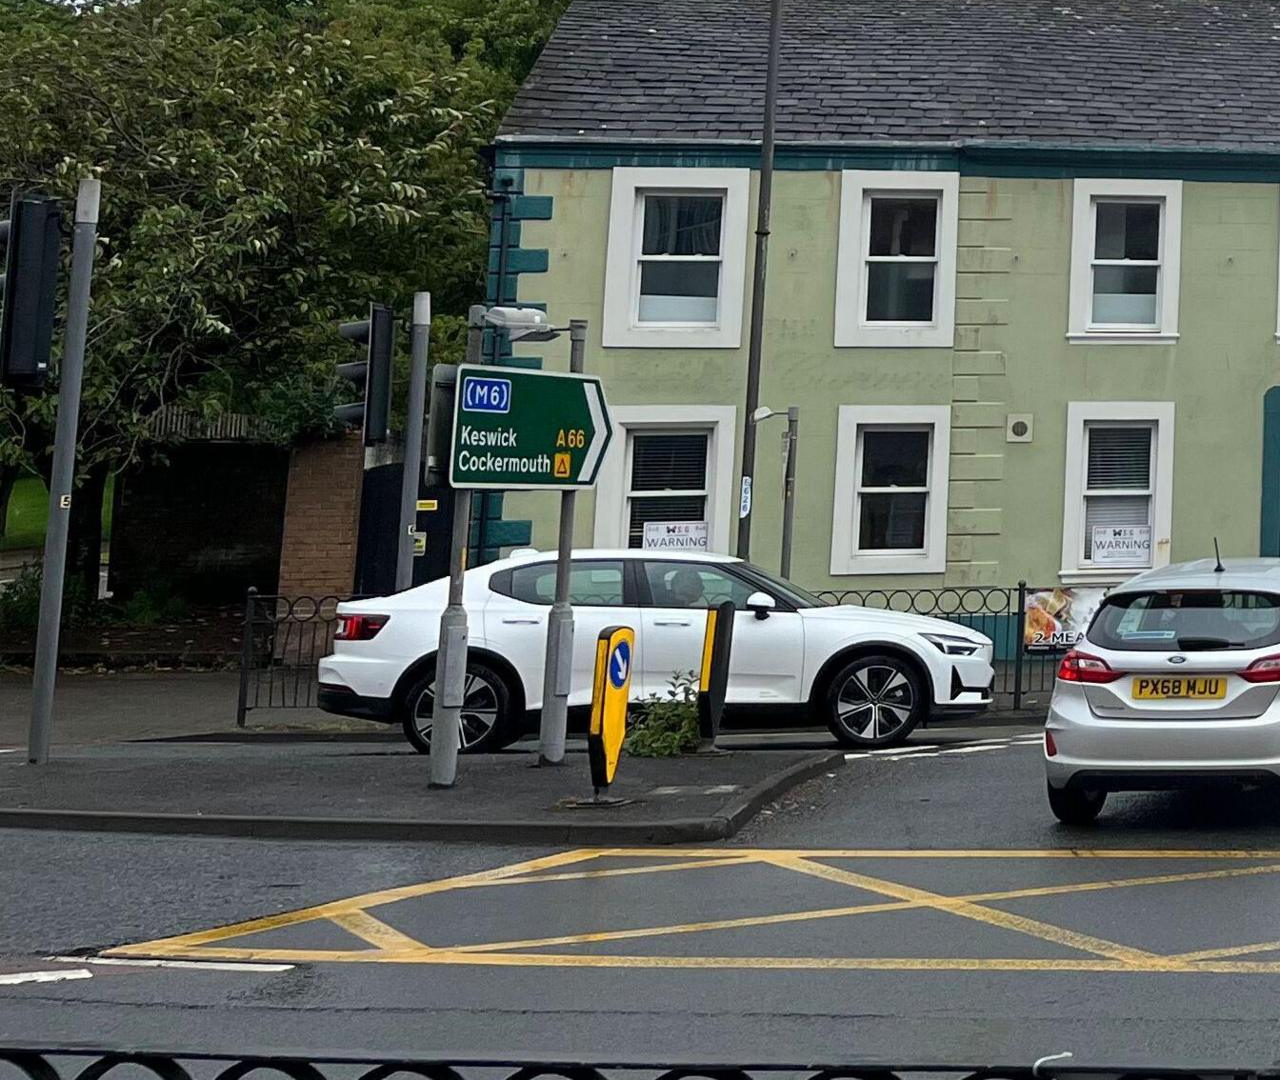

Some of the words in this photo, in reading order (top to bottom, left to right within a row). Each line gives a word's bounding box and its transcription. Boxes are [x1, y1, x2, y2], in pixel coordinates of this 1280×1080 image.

[466, 381, 508, 409] (M6)
[460, 425, 517, 447] Keswick
[556, 429, 585, 448] A66
[458, 450, 551, 473] Cockermouth
[646, 536, 707, 548] WARNING
[1094, 539, 1151, 550] WARNING
[1034, 632, 1045, 644] 2
[1138, 679, 1183, 696] PX68
[1185, 679, 1220, 696] MJU
